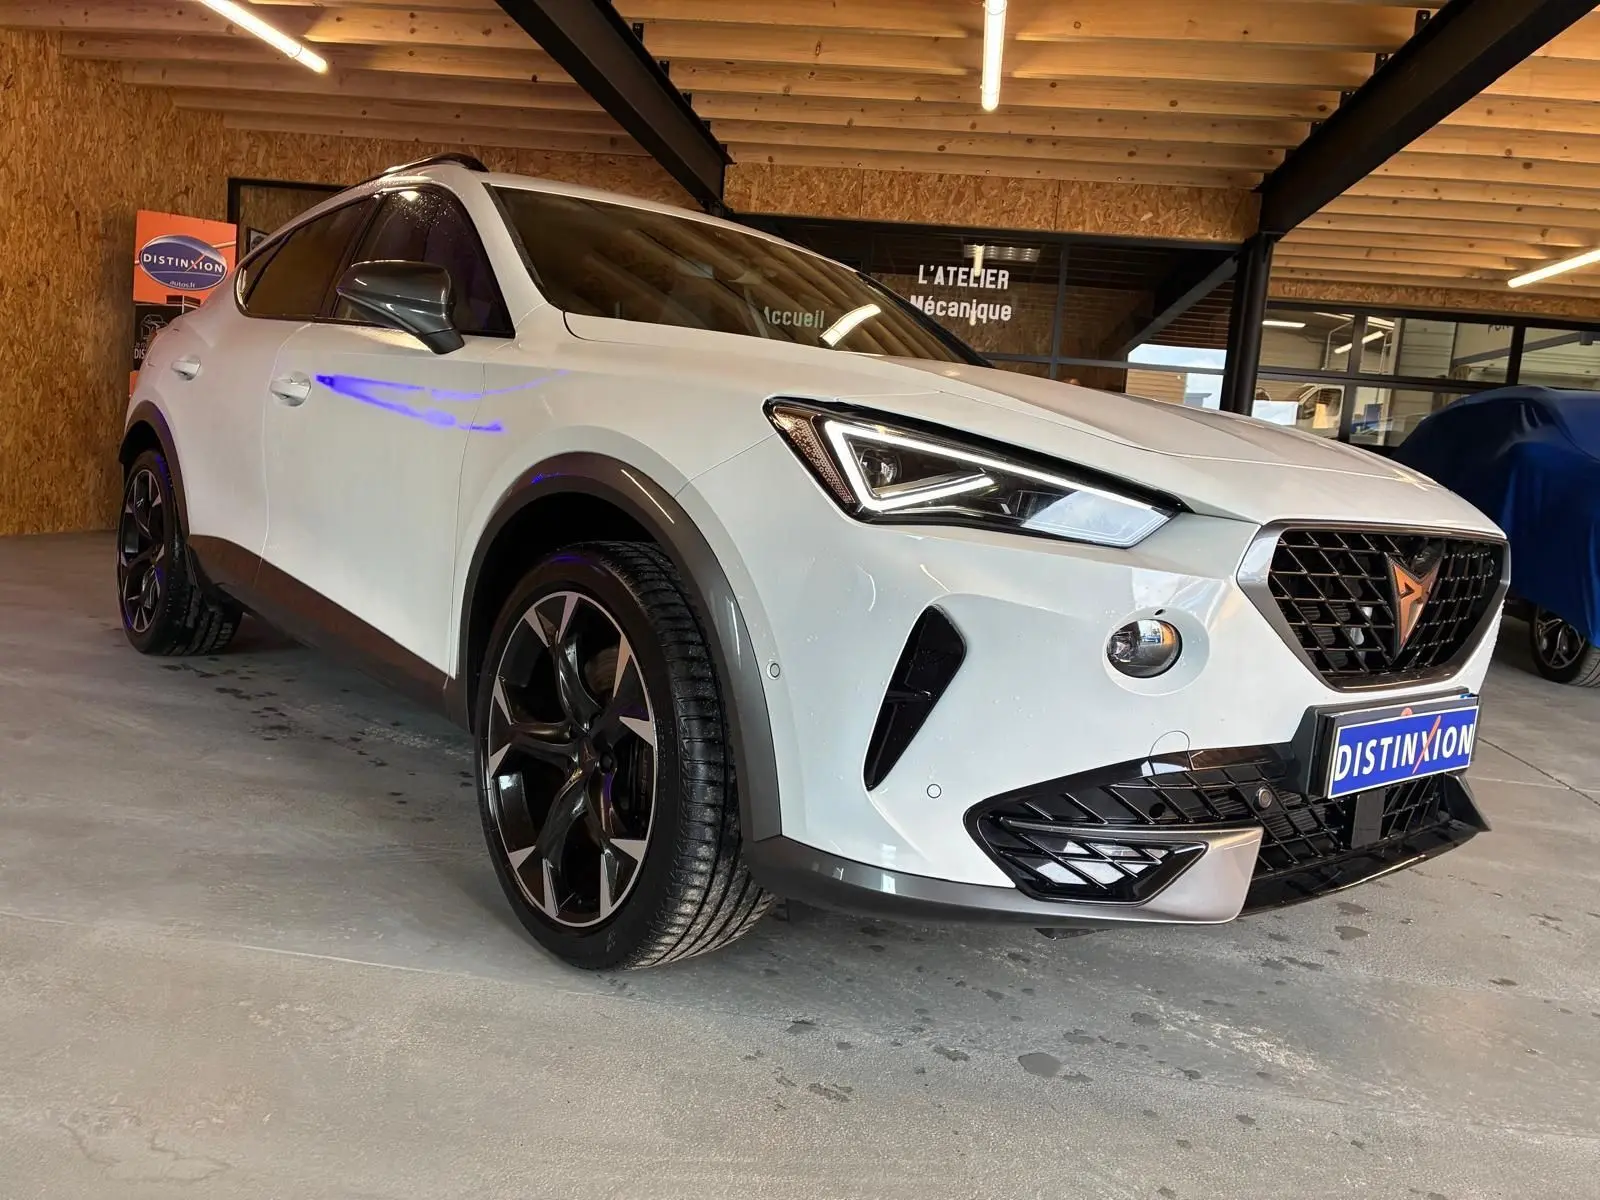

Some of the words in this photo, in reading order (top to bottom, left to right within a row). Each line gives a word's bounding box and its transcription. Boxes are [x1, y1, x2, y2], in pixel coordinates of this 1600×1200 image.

[143, 253, 223, 273] DISTINXION
[917, 264, 1010, 290] L'ATELIER
[910, 294, 1012, 324] Mécanique
[1333, 721, 1474, 781] DISTINXION
